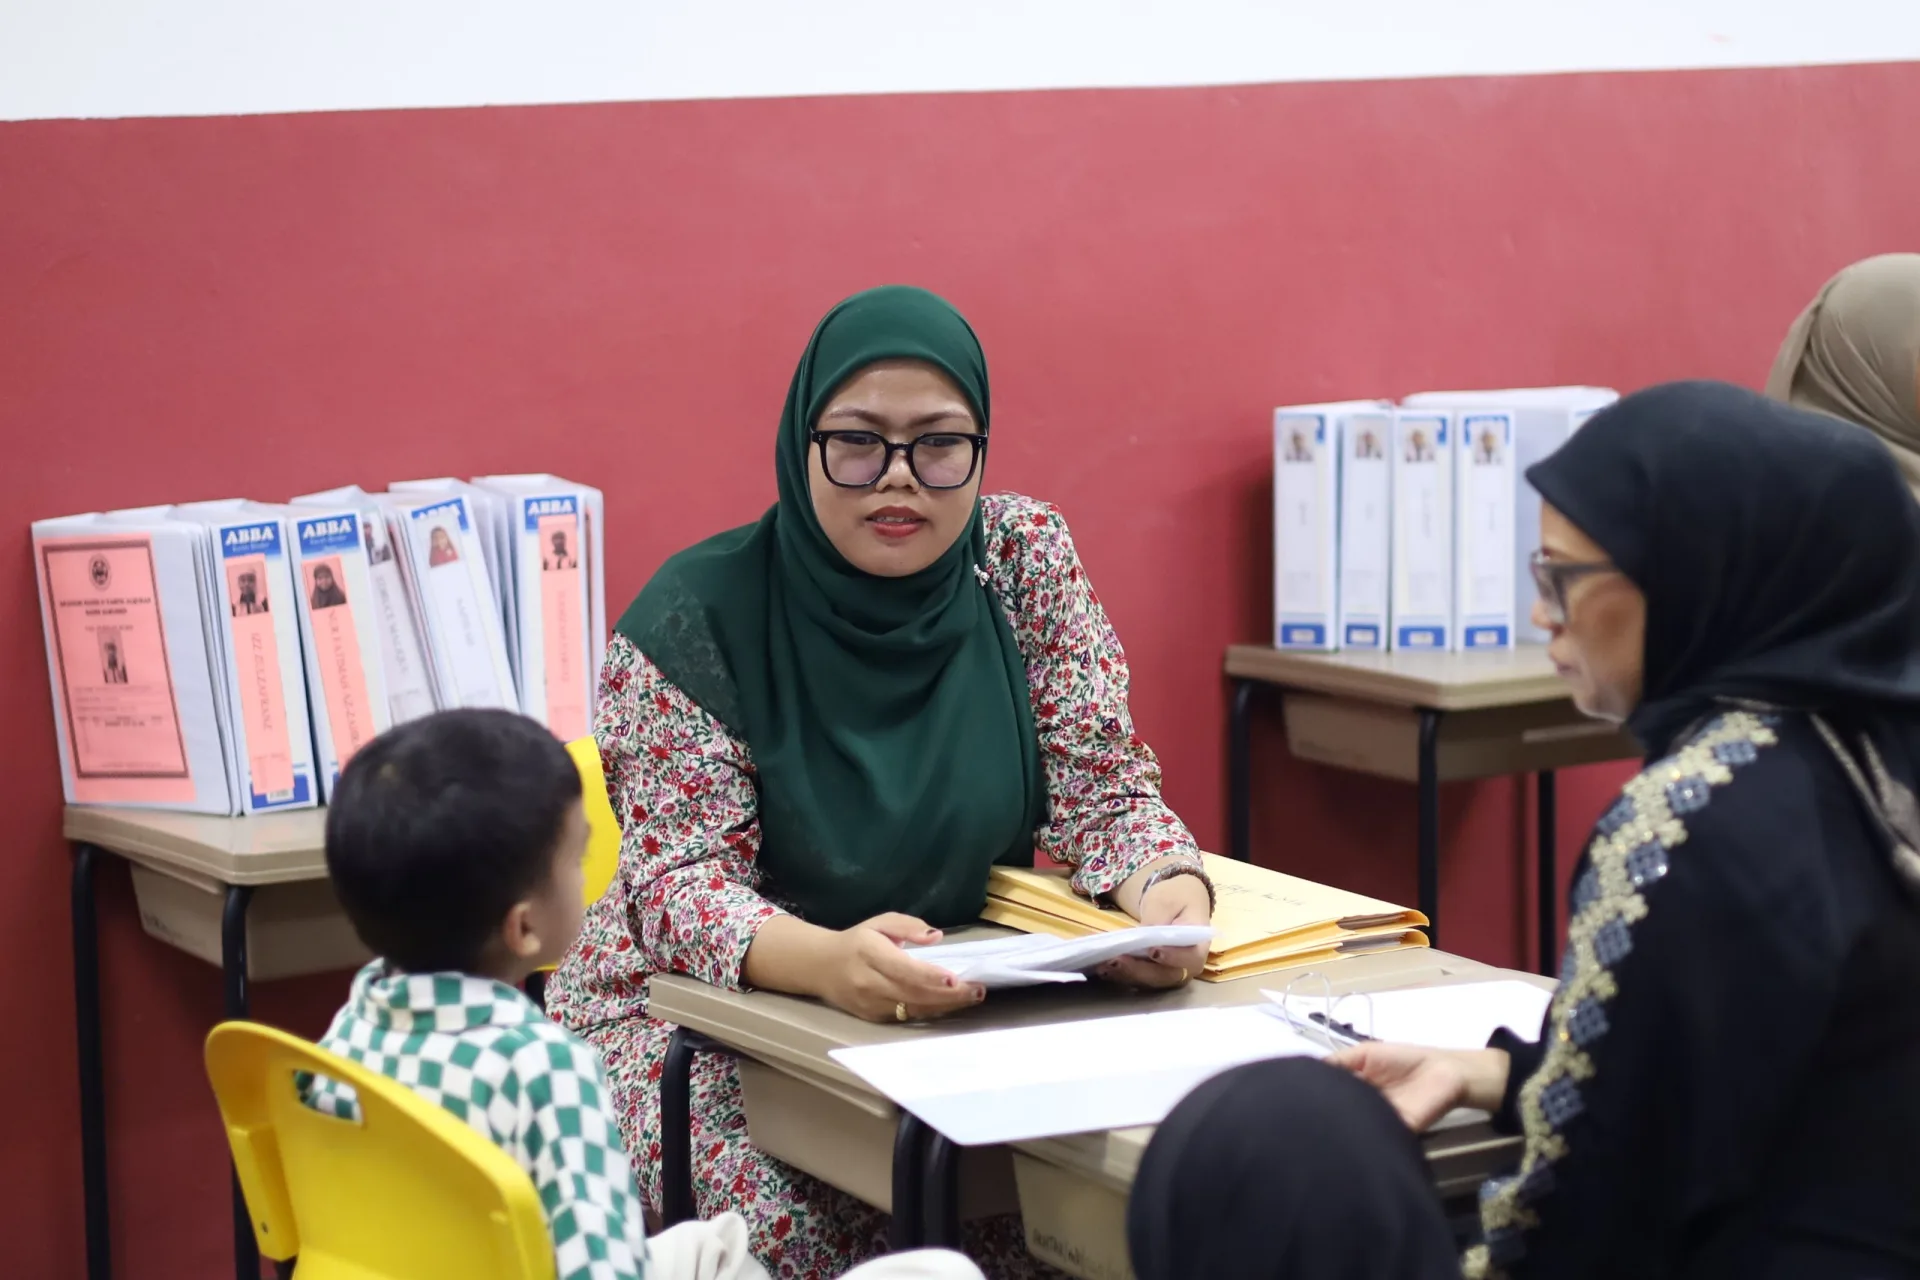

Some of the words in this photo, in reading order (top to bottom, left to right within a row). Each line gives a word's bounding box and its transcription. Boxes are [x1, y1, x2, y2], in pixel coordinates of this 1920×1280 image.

[528, 500, 573, 515] ABBA
[225, 526, 274, 546] ABBA
[302, 518, 352, 539] ABBA
